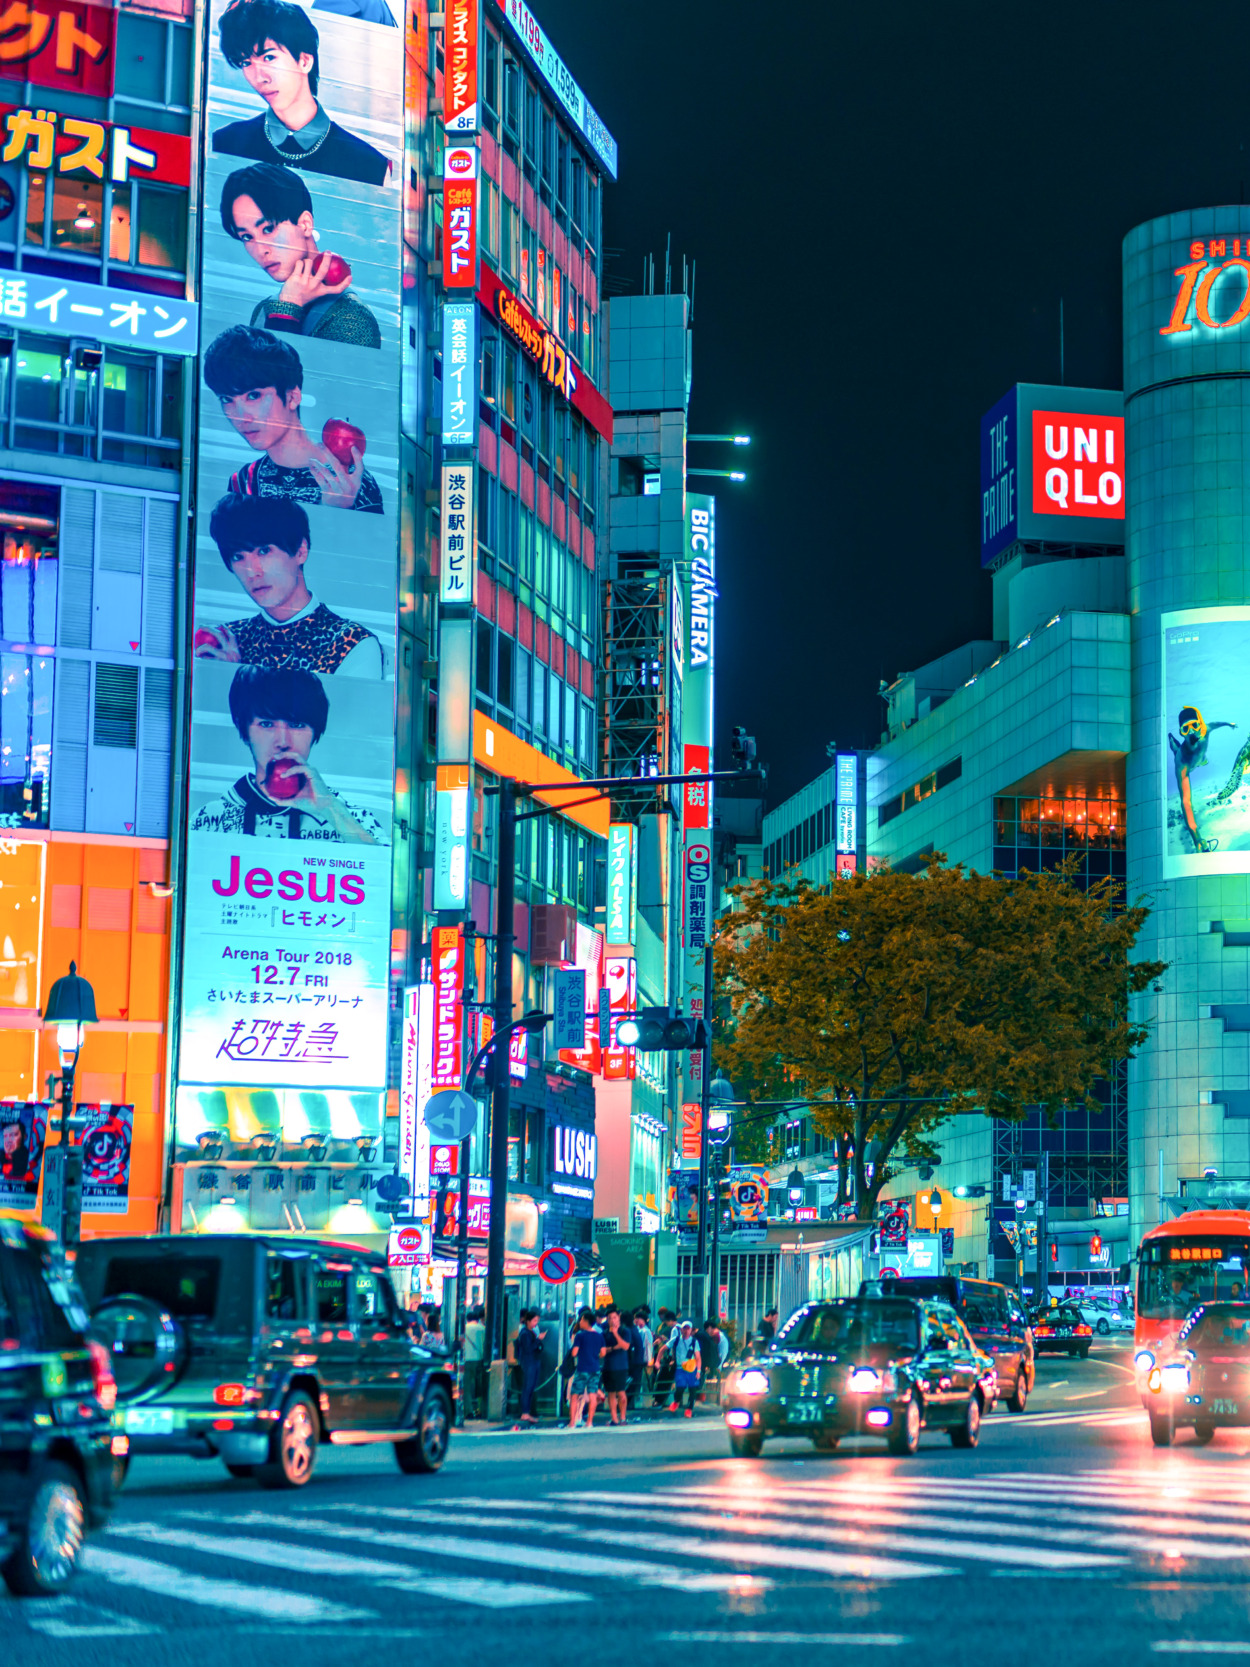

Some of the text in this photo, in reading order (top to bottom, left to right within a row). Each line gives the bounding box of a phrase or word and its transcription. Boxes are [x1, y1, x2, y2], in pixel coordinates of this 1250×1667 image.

[457, 117, 474, 129] 8F
[2, 109, 157, 184] ガスト
[448, 189, 472, 199] Café
[449, 206, 471, 274] ガスト
[446, 306, 473, 314] AEON
[450, 318, 468, 430] 英会話イーオン
[541, 334, 577, 401] ガスト
[450, 433, 466, 443] 6F
[1044, 423, 1115, 464] UNI
[982, 467, 1016, 545] PRIME
[1044, 466, 1123, 509] QLO
[447, 473, 467, 592] 渋谷駅前ビル
[690, 508, 719, 667] BIC CAMERA
[1169, 629, 1200, 638] GoPro
[211, 855, 366, 905] Jesus
[303, 857, 366, 870] NEW SINGLE
[689, 845, 710, 882] OS
[689, 885, 706, 949] 調剤薬局
[221, 946, 352, 966] Arena Tour 2018
[250, 964, 329, 988] 12.7 FRI
[206, 989, 364, 1009] さいたまスーパーアリーナ
[567, 975, 582, 1043] 渋谷駅前
[437, 971, 458, 1076] サンドラッグ
[609, 1059, 623, 1069] 3F
[554, 1125, 596, 1180] LUSH
[199, 1172, 382, 1192] 渋谷駅前ビル
[400, 1236, 420, 1246] ガスト
[610, 1237, 645, 1245] SMOKING
